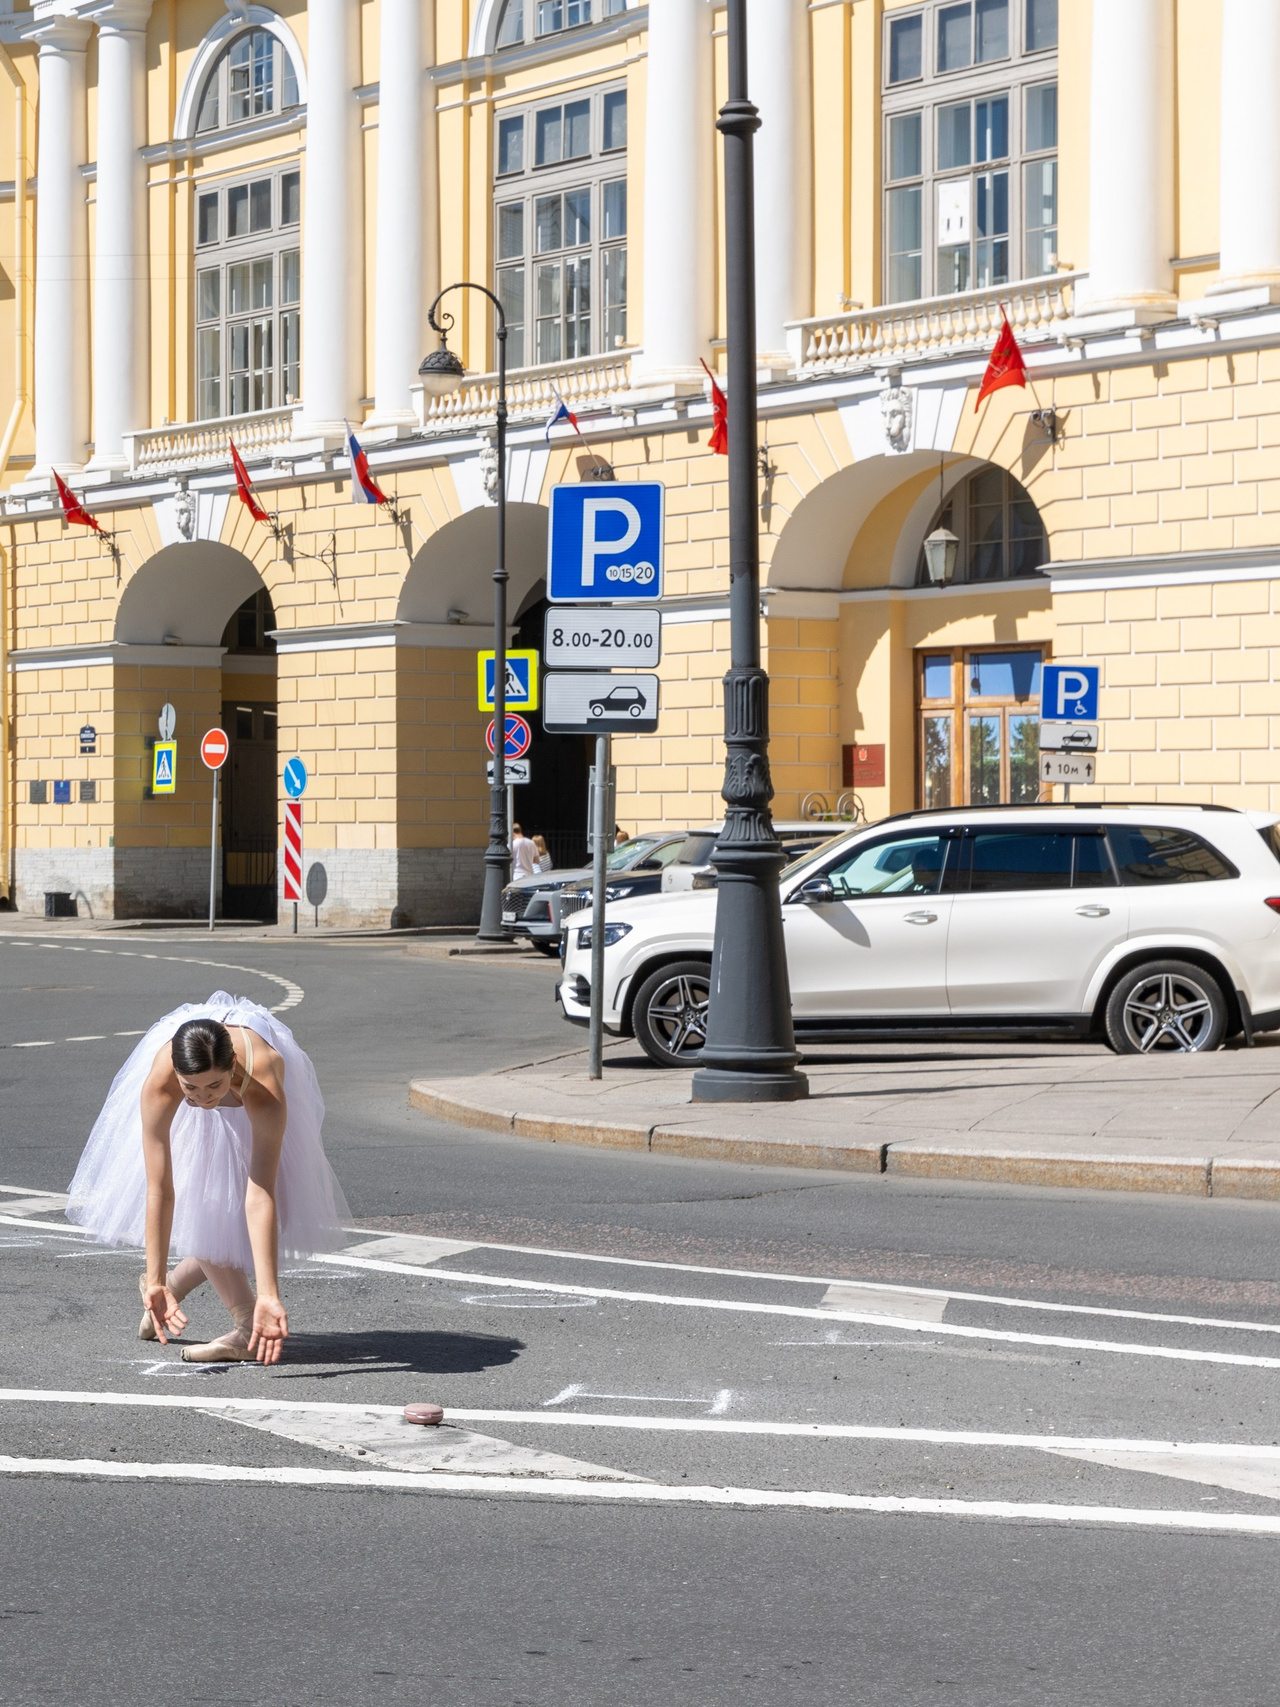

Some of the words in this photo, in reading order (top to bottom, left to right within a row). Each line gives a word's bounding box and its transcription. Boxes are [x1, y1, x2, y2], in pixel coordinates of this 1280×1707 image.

[581, 497, 642, 587] P
[621, 567, 632, 579] 15
[636, 566, 653, 580] 20
[552, 628, 653, 648] 8.00-20.00
[1057, 671, 1089, 715] P
